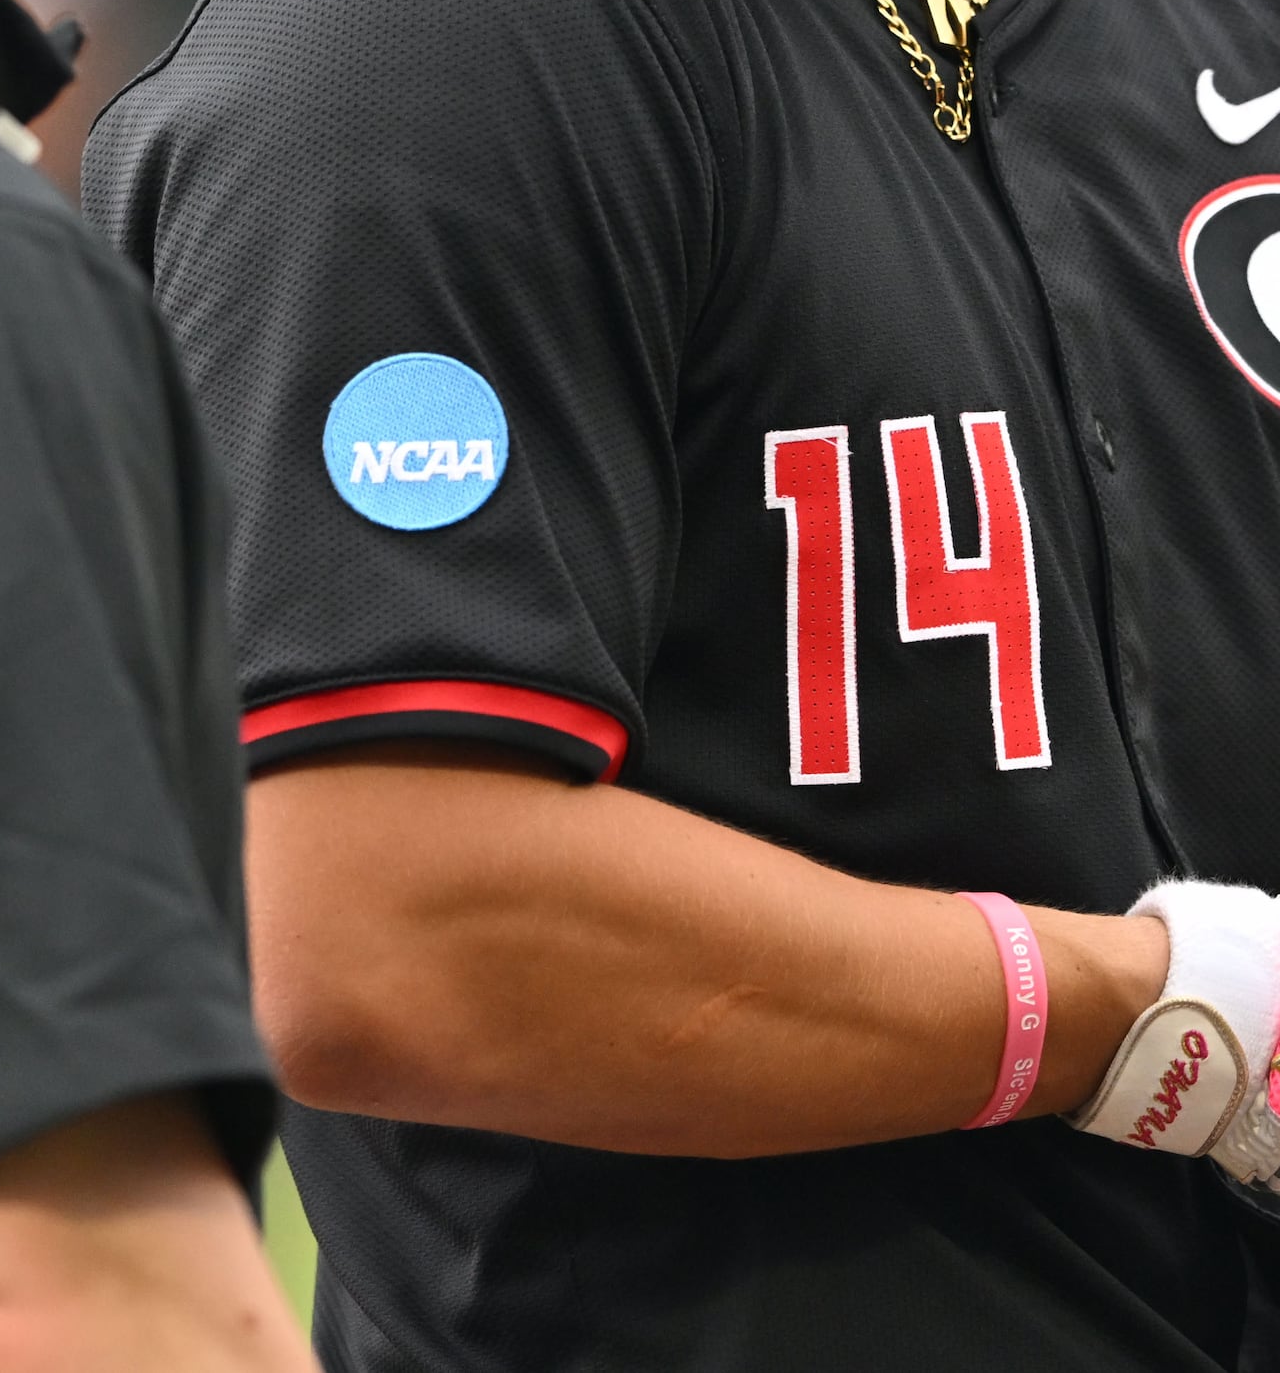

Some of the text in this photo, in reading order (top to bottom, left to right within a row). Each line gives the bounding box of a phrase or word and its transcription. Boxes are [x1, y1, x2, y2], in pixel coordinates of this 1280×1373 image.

[349, 440, 496, 484] NCAA
[765, 411, 1052, 785] 14
[1006, 926, 1040, 1031] Kenny G
